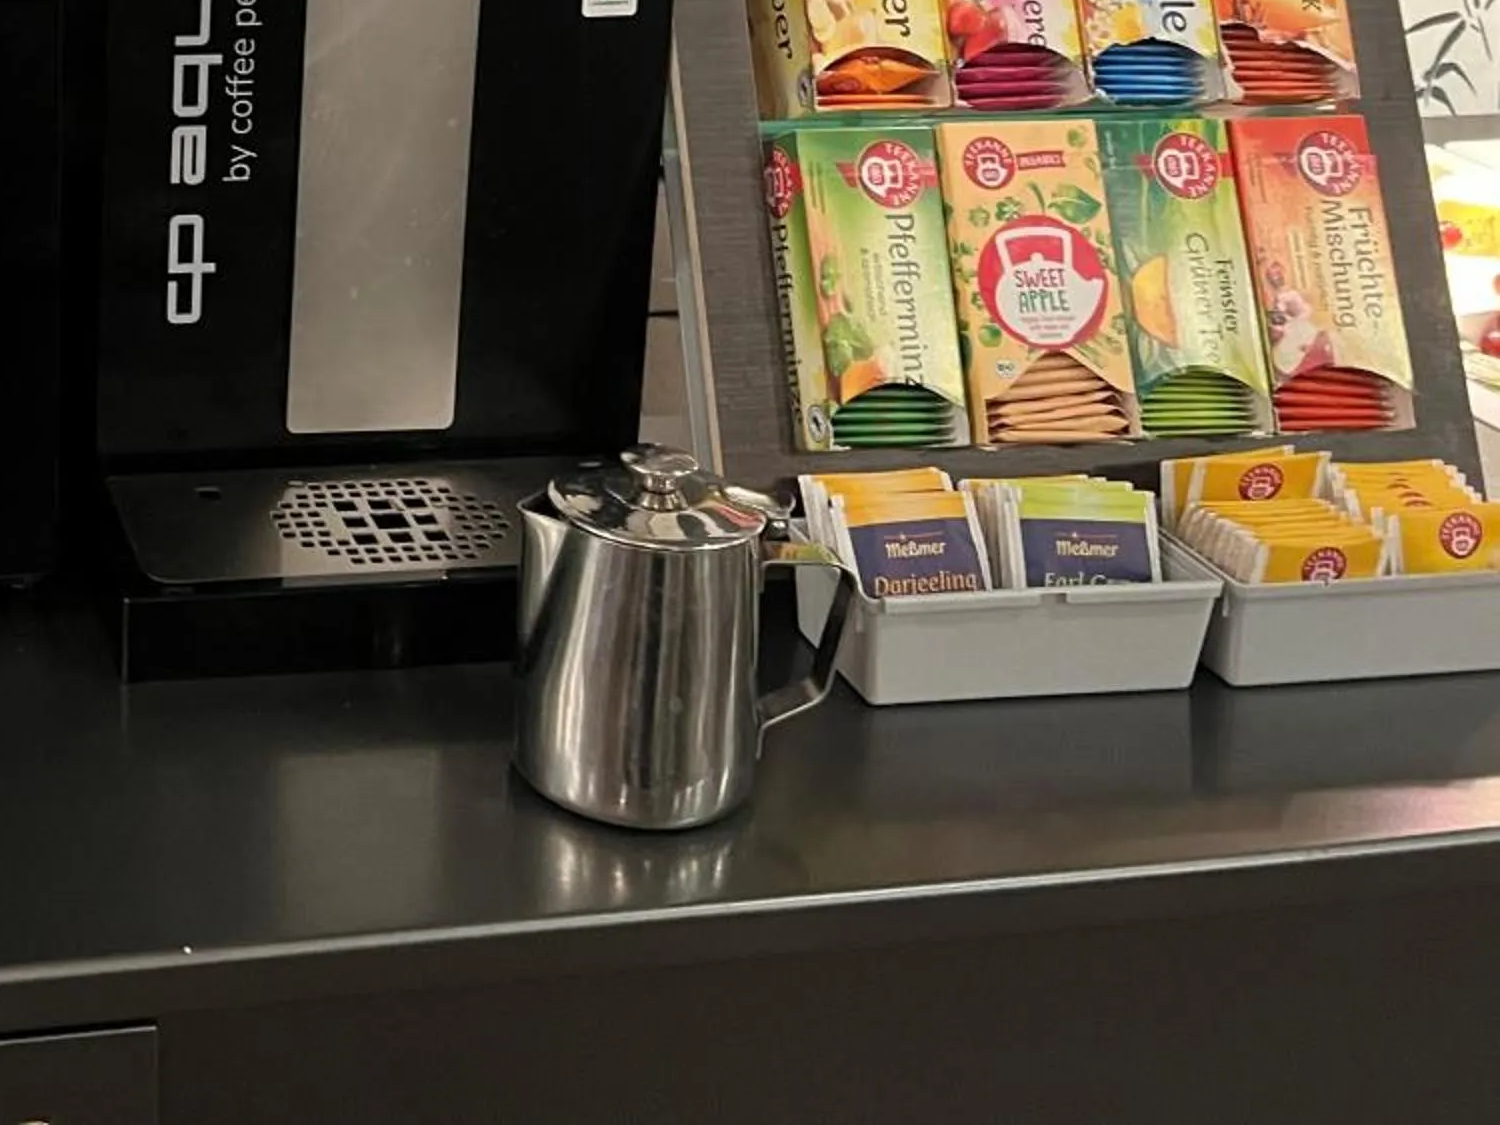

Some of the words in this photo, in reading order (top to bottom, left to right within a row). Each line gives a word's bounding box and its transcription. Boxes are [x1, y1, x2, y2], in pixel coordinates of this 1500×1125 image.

[225, 38, 255, 135] coffee
[222, 144, 258, 183] by
[167, 214, 216, 324] cp
[1014, 267, 1065, 288] SWEET
[1184, 232, 1214, 318] Grüner
[1320, 198, 1357, 328] Mischung
[1019, 288, 1071, 313] APPLE
[1213, 259, 1239, 333] Feinster
[1197, 323, 1224, 364] Tee
[874, 570, 977, 597] Darjeeling
